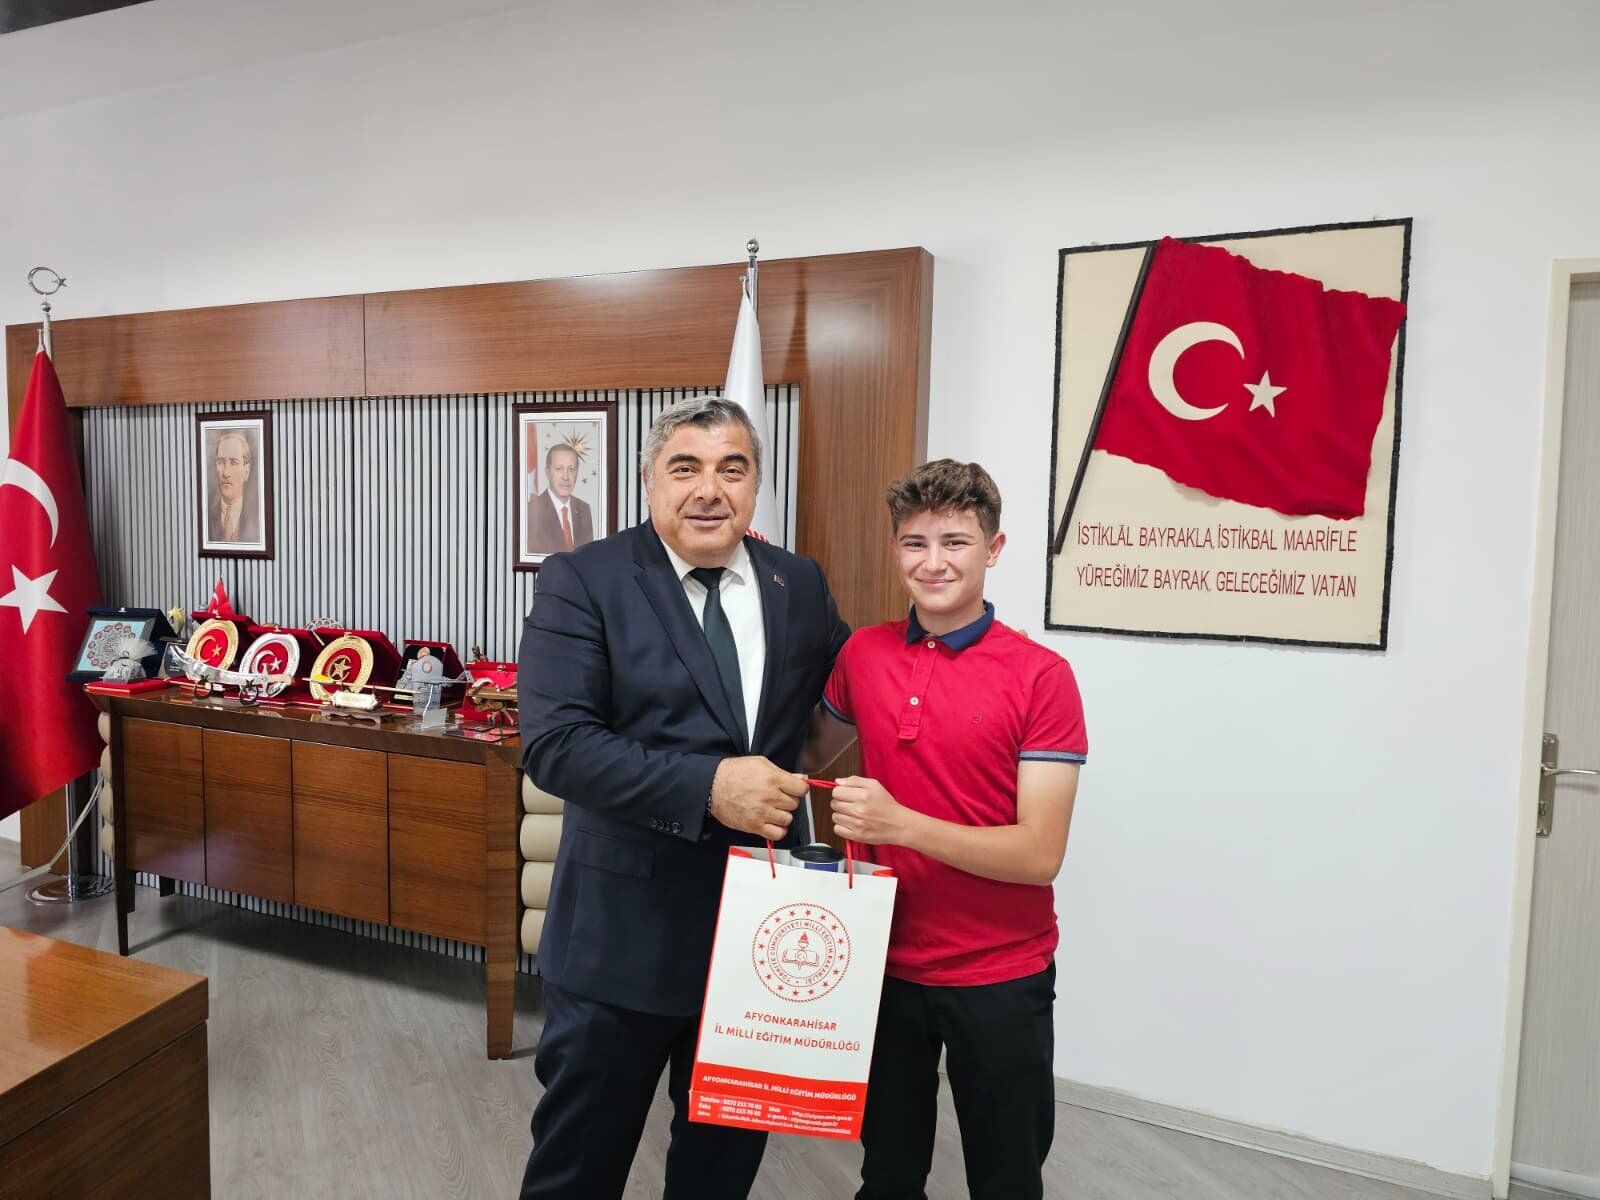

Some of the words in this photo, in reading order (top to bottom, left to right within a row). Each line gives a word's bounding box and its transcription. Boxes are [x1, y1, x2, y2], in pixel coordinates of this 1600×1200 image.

[1218, 524, 1277, 550] İSTİKBAL
[1283, 527, 1357, 552] MAARİFLE
[1077, 563, 1149, 588] YÜREĞİMİZ
[1216, 569, 1306, 595] GELECEĞİMİZ
[1311, 574, 1357, 598] VATAN
[744, 1011, 837, 1031] AFYONKARAHİSAR
[714, 1022, 724, 1034] İL
[726, 1025, 754, 1039] MİLLİ
[756, 1030, 792, 1045] EĞİTİM
[794, 1036, 862, 1052] MÜDÜRLÜĞÜ
[702, 1075, 764, 1090] AFYONKARAHİSAR
